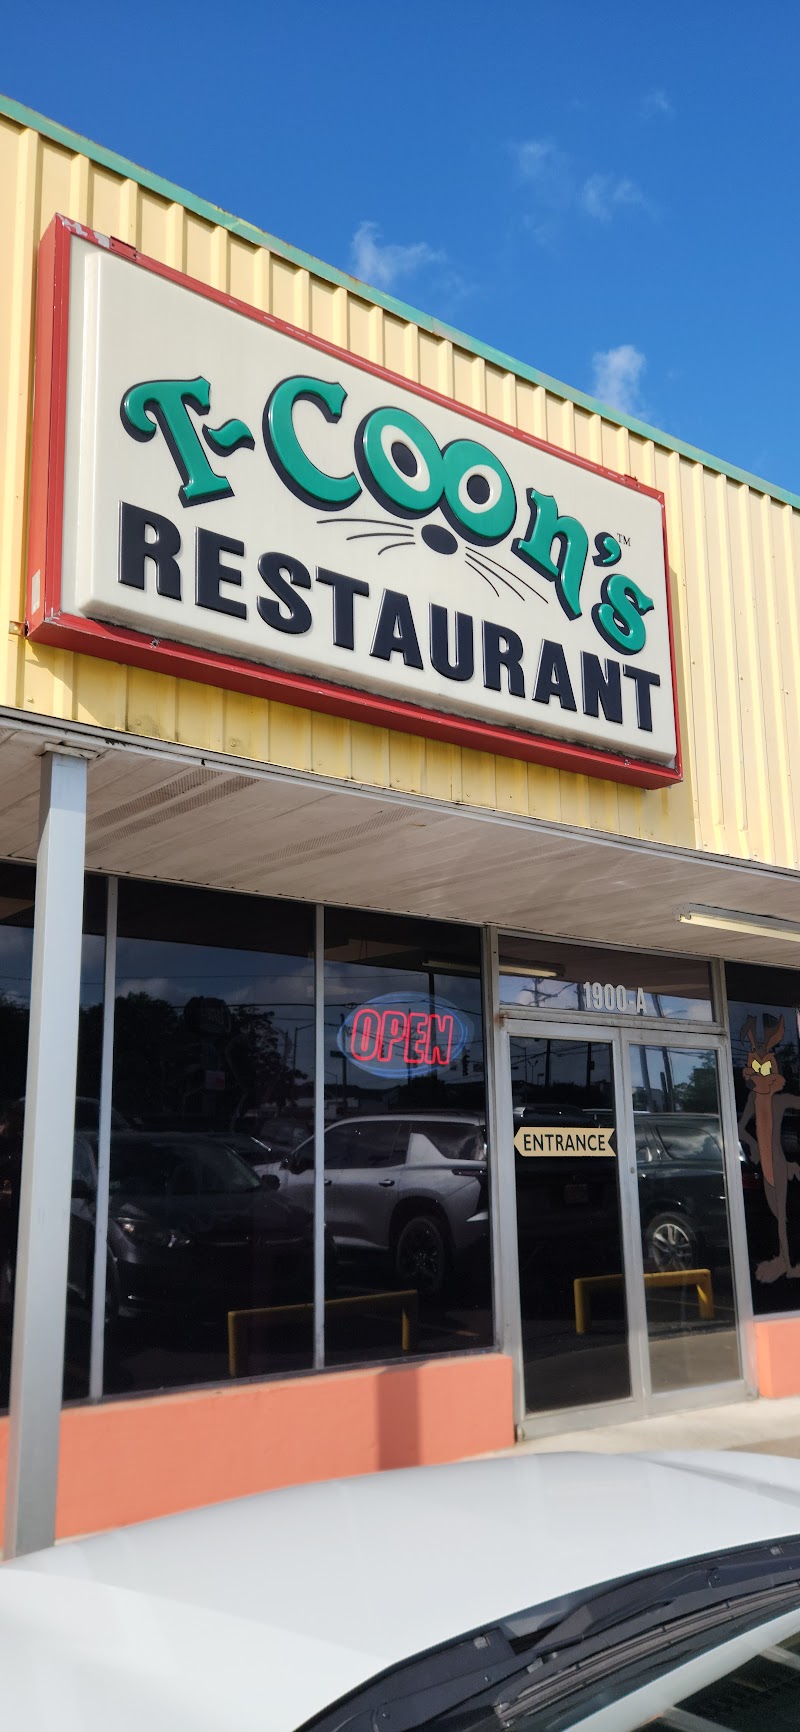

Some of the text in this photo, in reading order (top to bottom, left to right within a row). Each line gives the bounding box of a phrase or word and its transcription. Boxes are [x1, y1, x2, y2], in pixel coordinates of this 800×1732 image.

[617, 533, 631, 547] TM
[118, 501, 661, 732] RESTAURANT
[583, 981, 648, 1014] 1900-A
[350, 1008, 453, 1065] OPEN
[523, 1134, 606, 1151] ENTRANCE
